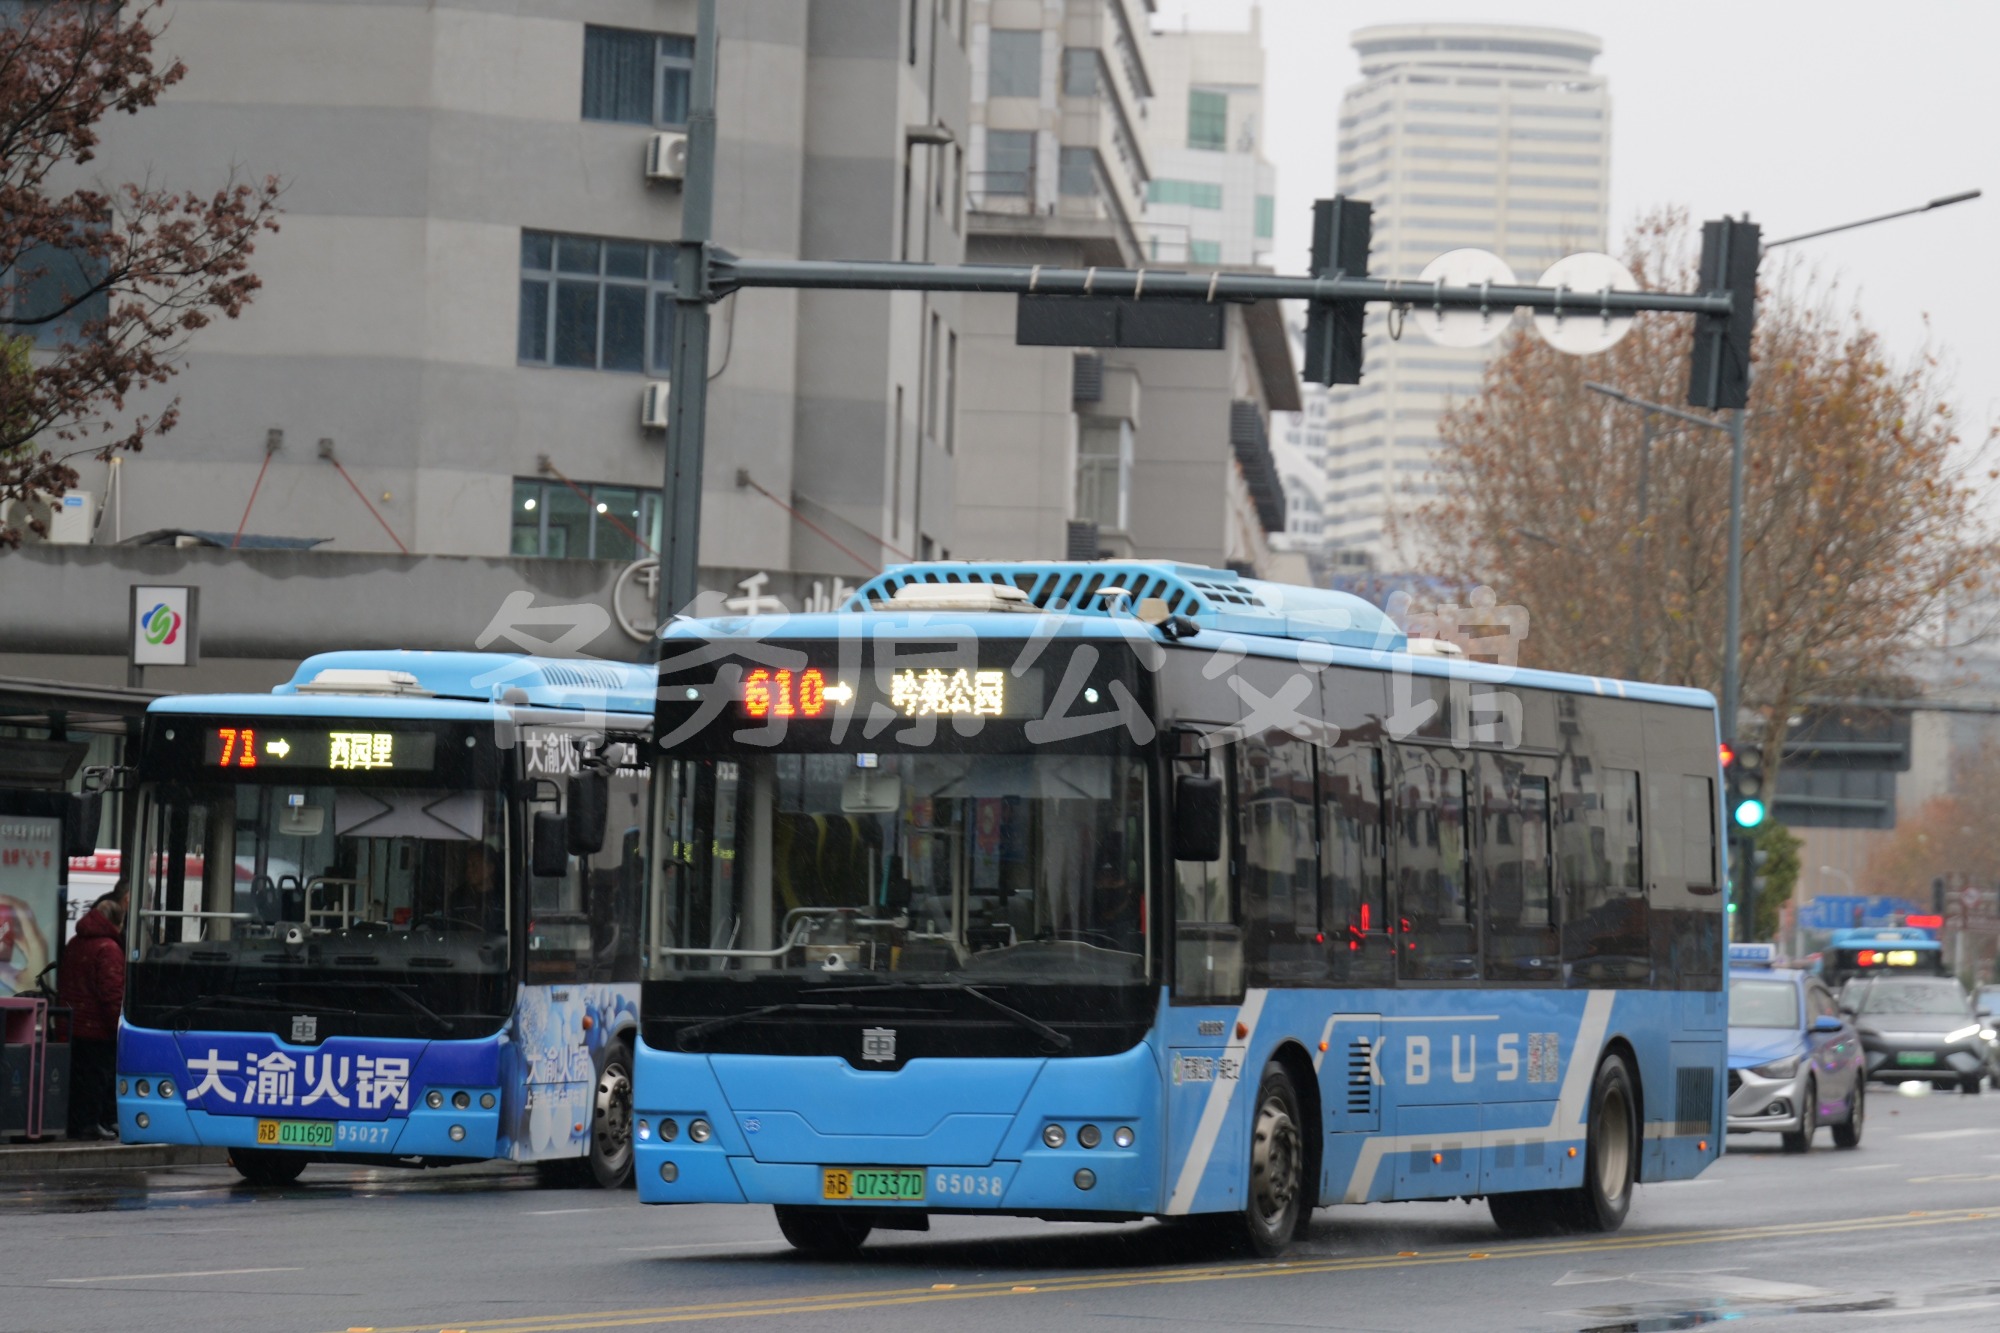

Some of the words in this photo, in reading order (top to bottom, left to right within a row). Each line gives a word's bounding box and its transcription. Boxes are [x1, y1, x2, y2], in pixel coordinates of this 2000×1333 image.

[745, 668, 825, 716] 610
[219, 728, 256, 767] 71
[329, 732, 393, 770] 西园里
[186, 1048, 409, 1110] 大渝火锅
[282, 1124, 332, 1144] 01169D
[337, 1124, 389, 1144] 95027
[856, 1173, 922, 1196] 07337D
[935, 1173, 1002, 1197] 65038
